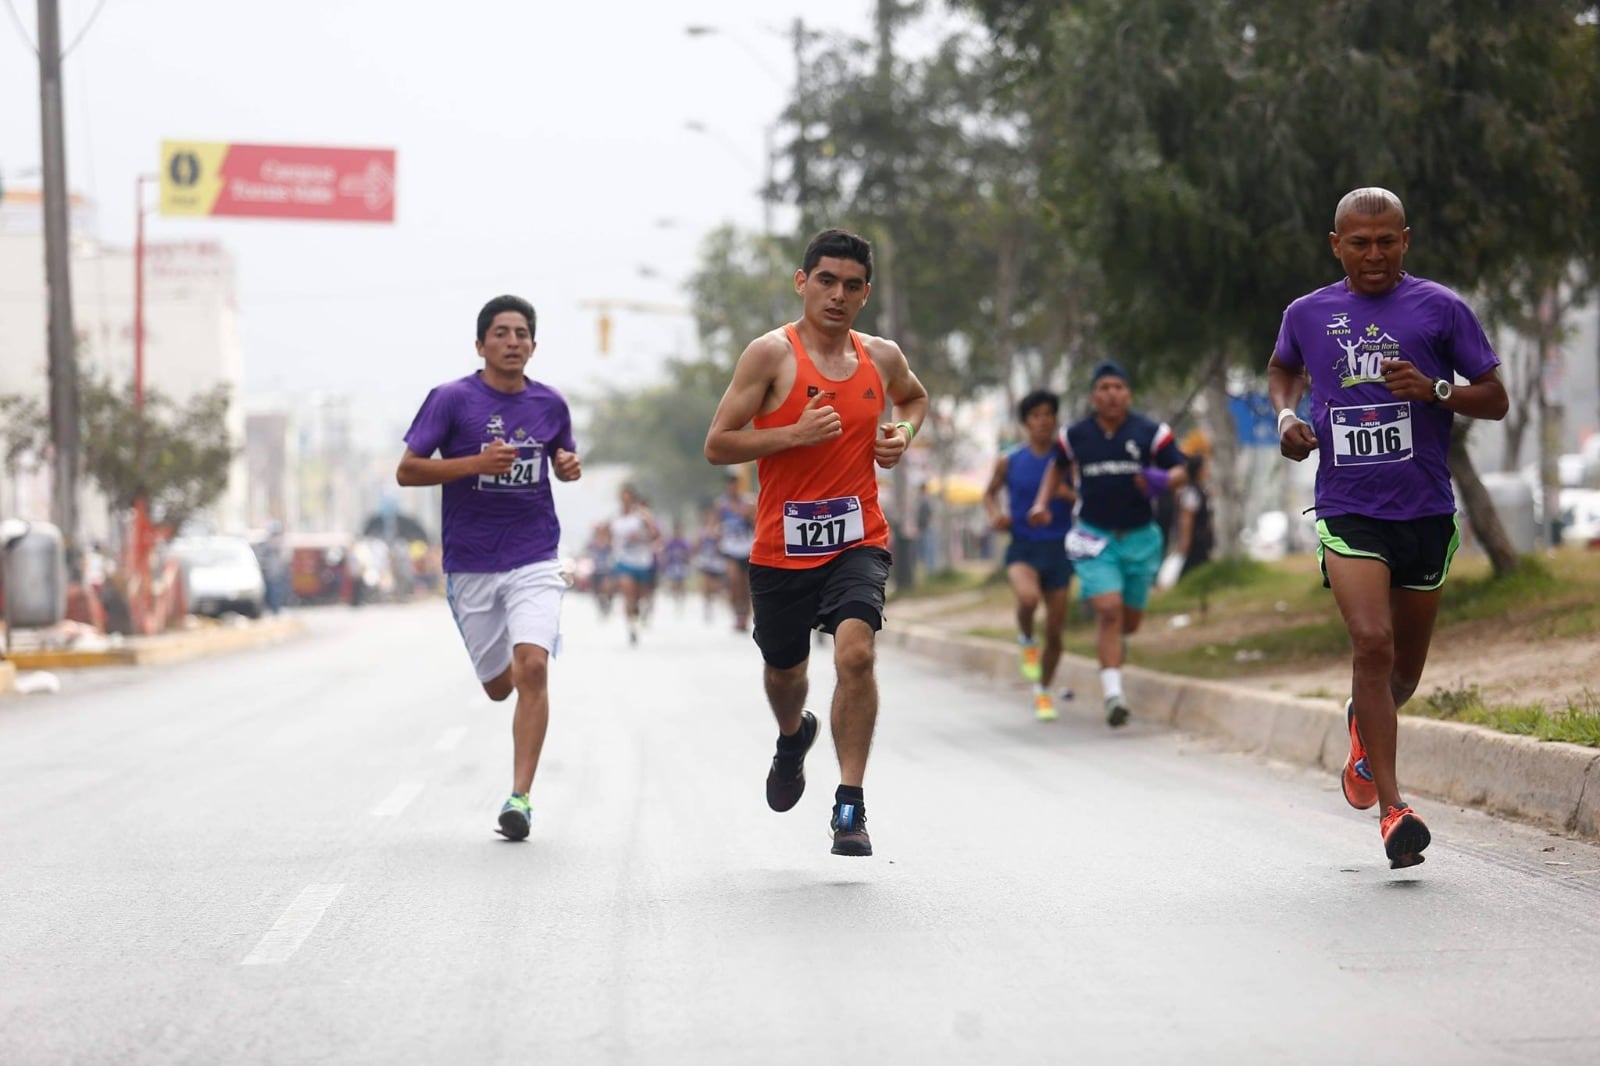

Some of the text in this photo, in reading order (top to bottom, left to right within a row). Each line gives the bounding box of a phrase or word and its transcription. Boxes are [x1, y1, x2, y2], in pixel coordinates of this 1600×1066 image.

[1357, 351, 1400, 380] 10
[1345, 427, 1401, 456] 1016
[796, 519, 846, 547] 1217
